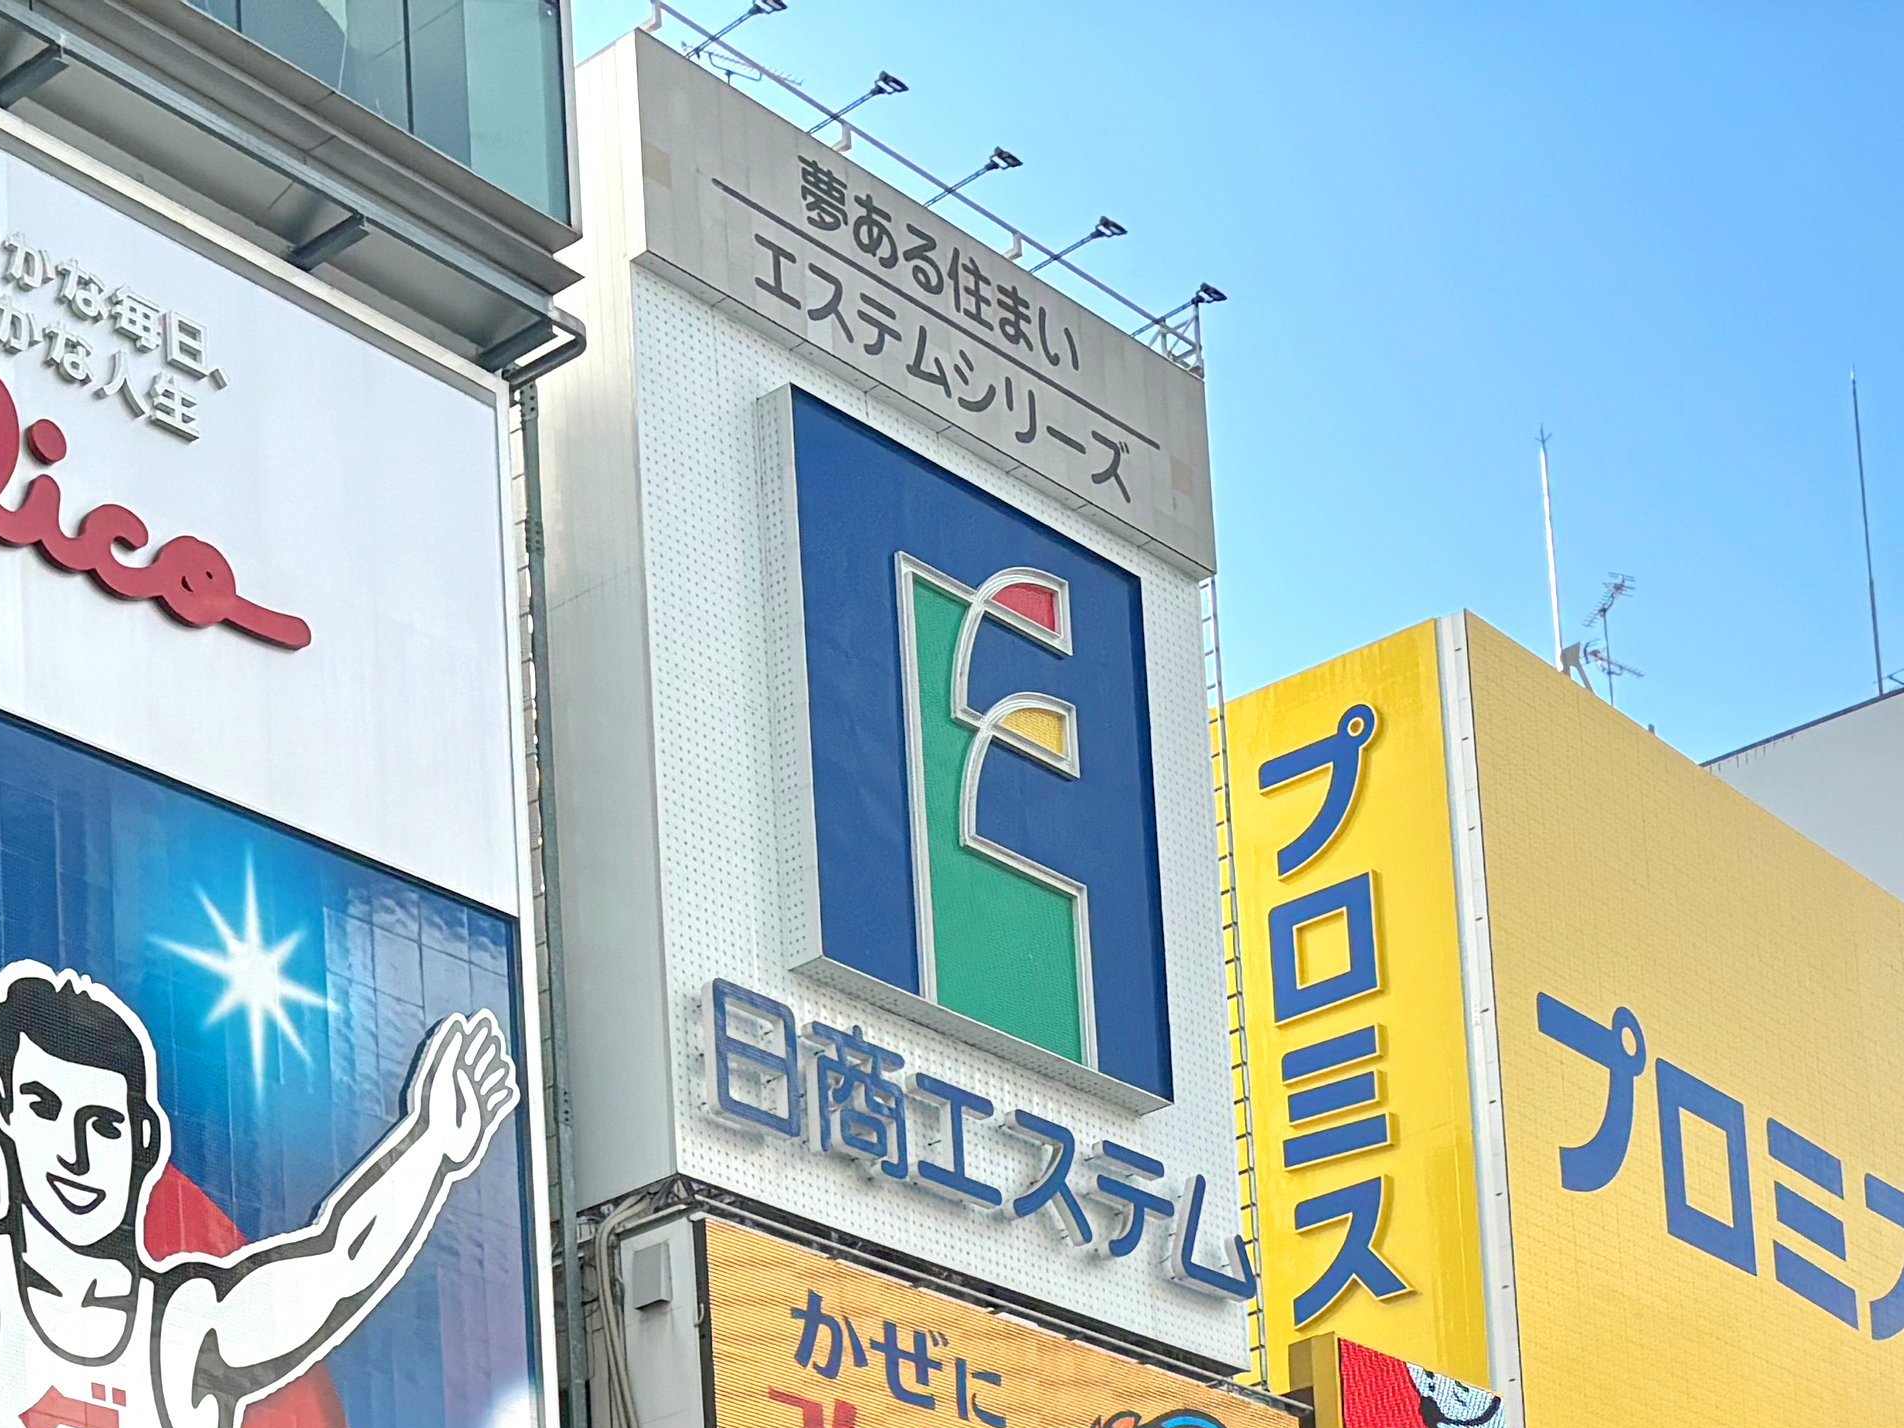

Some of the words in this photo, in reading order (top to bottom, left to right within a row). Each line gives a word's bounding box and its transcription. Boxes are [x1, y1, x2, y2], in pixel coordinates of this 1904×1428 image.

[754, 234, 1131, 503] エステムシリーズ
[797, 155, 1079, 371] 夢ある住まい
[702, 976, 1257, 1302] 日商エステム
[1258, 703, 1419, 1332] プロミス
